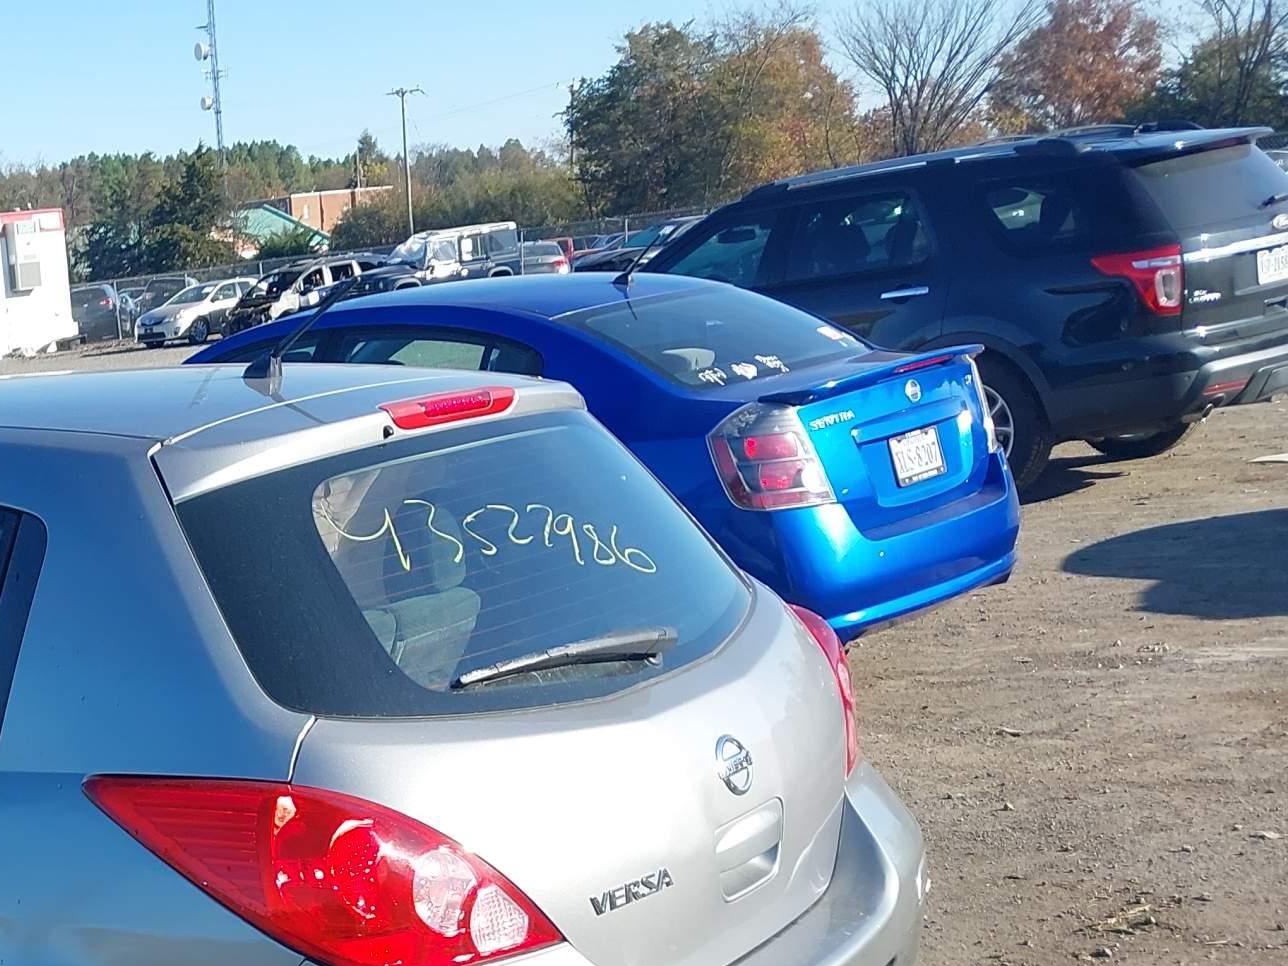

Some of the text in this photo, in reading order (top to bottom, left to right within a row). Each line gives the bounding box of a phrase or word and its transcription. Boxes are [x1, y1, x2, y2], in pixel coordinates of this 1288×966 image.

[808, 409, 856, 431] SENTRA
[319, 499, 657, 572] 43527986
[589, 868, 674, 916] VERSA
